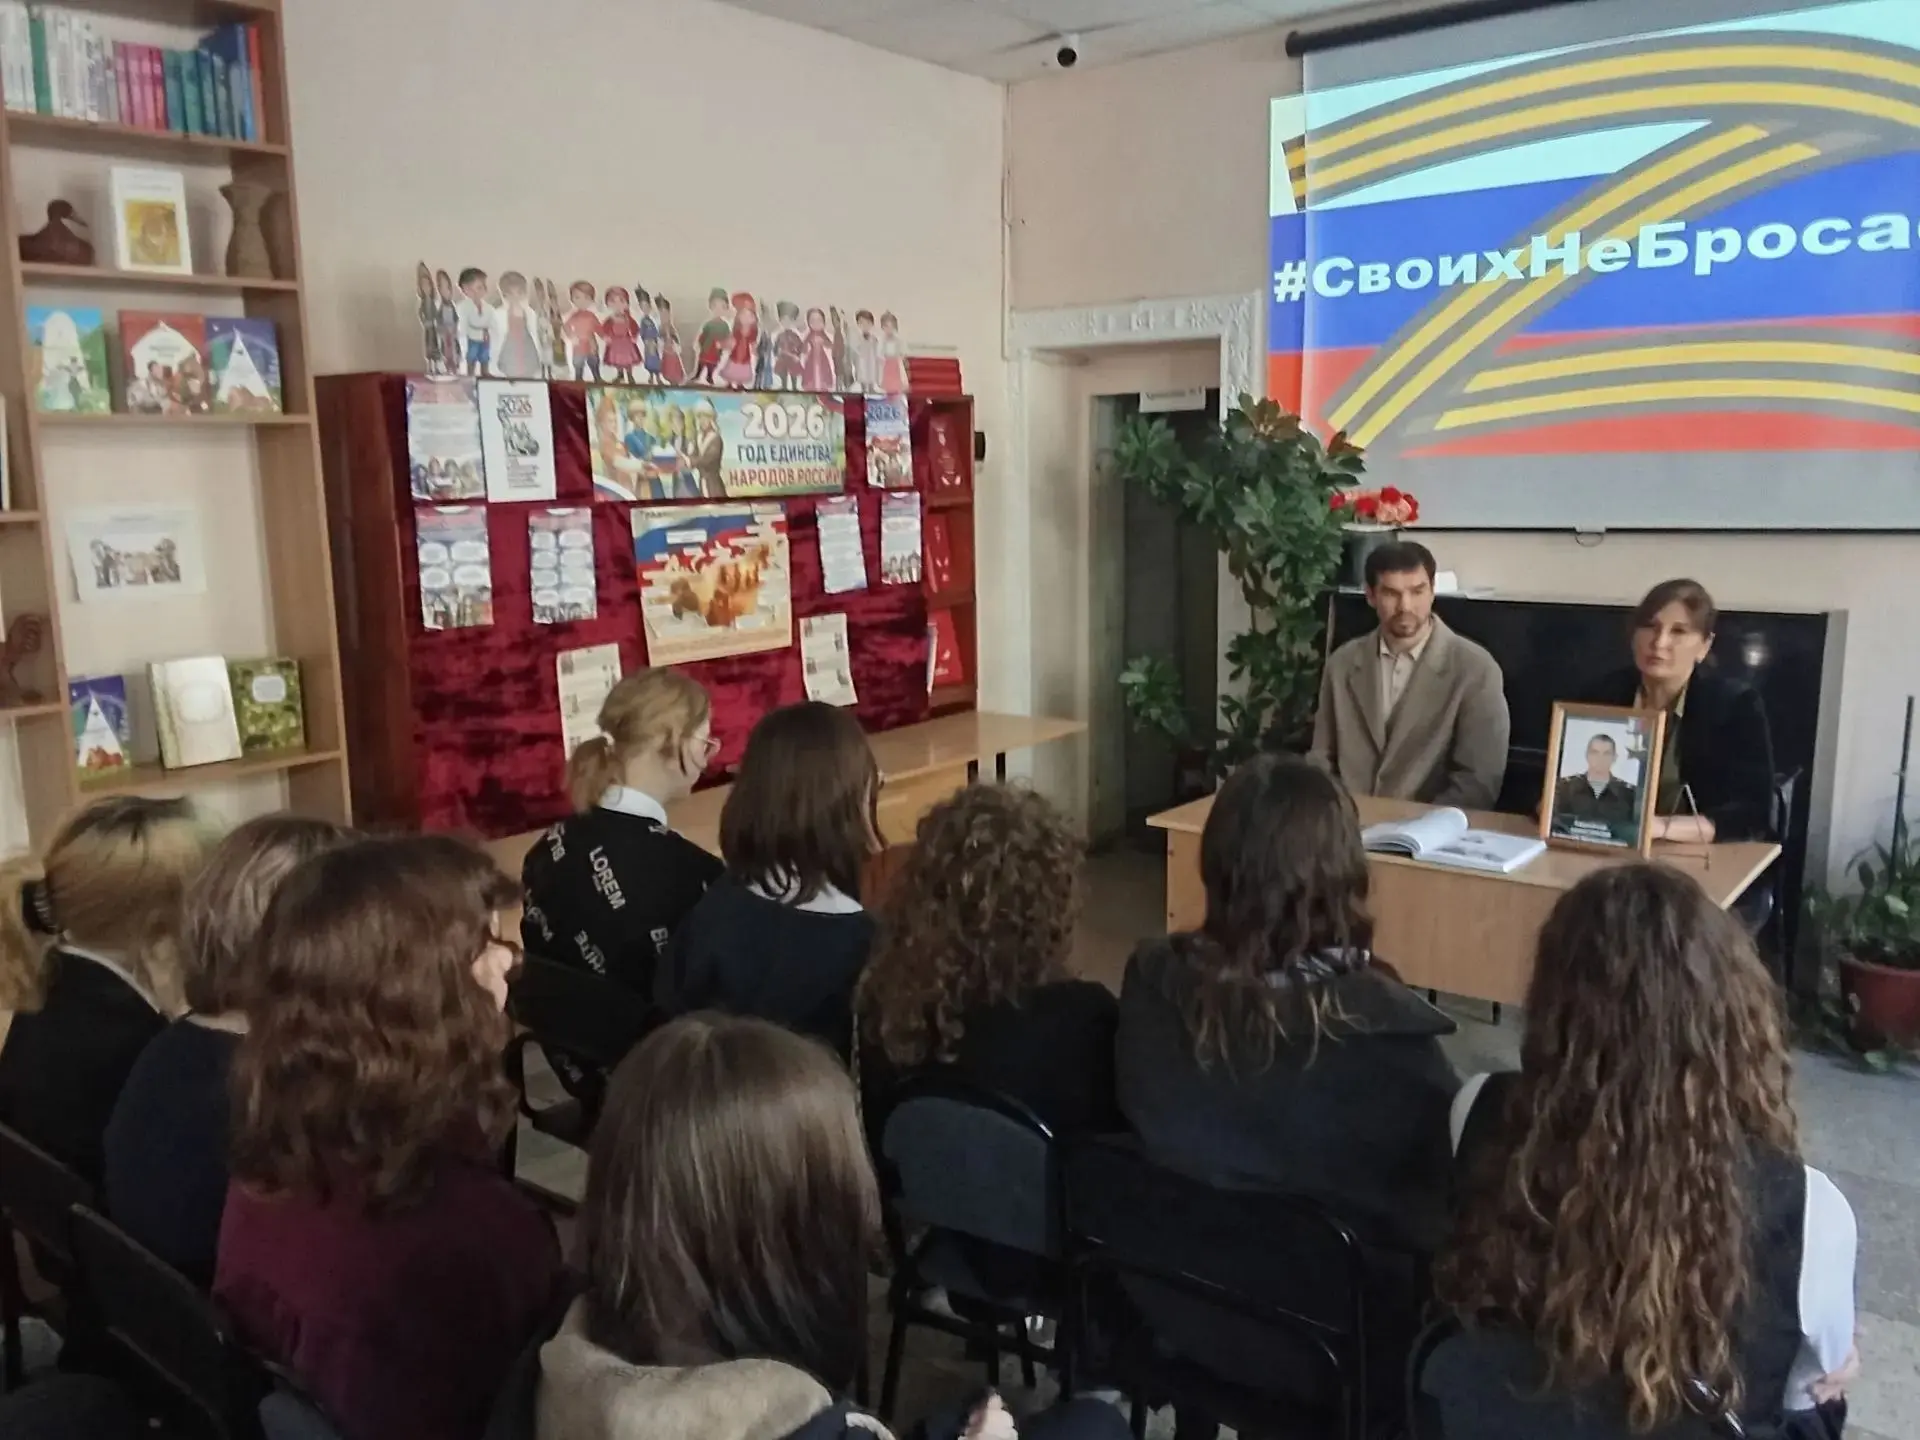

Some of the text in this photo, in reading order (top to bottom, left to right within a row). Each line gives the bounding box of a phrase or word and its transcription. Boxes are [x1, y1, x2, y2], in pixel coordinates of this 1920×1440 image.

[1273, 212, 1920, 303] #СвоихНеБроса
[741, 403, 824, 440] 2026
[737, 442, 832, 464] ГОД ЕДИНСТВА
[729, 466, 840, 487] НАРОДОВ РОССИИ
[589, 845, 626, 910] LOREM
